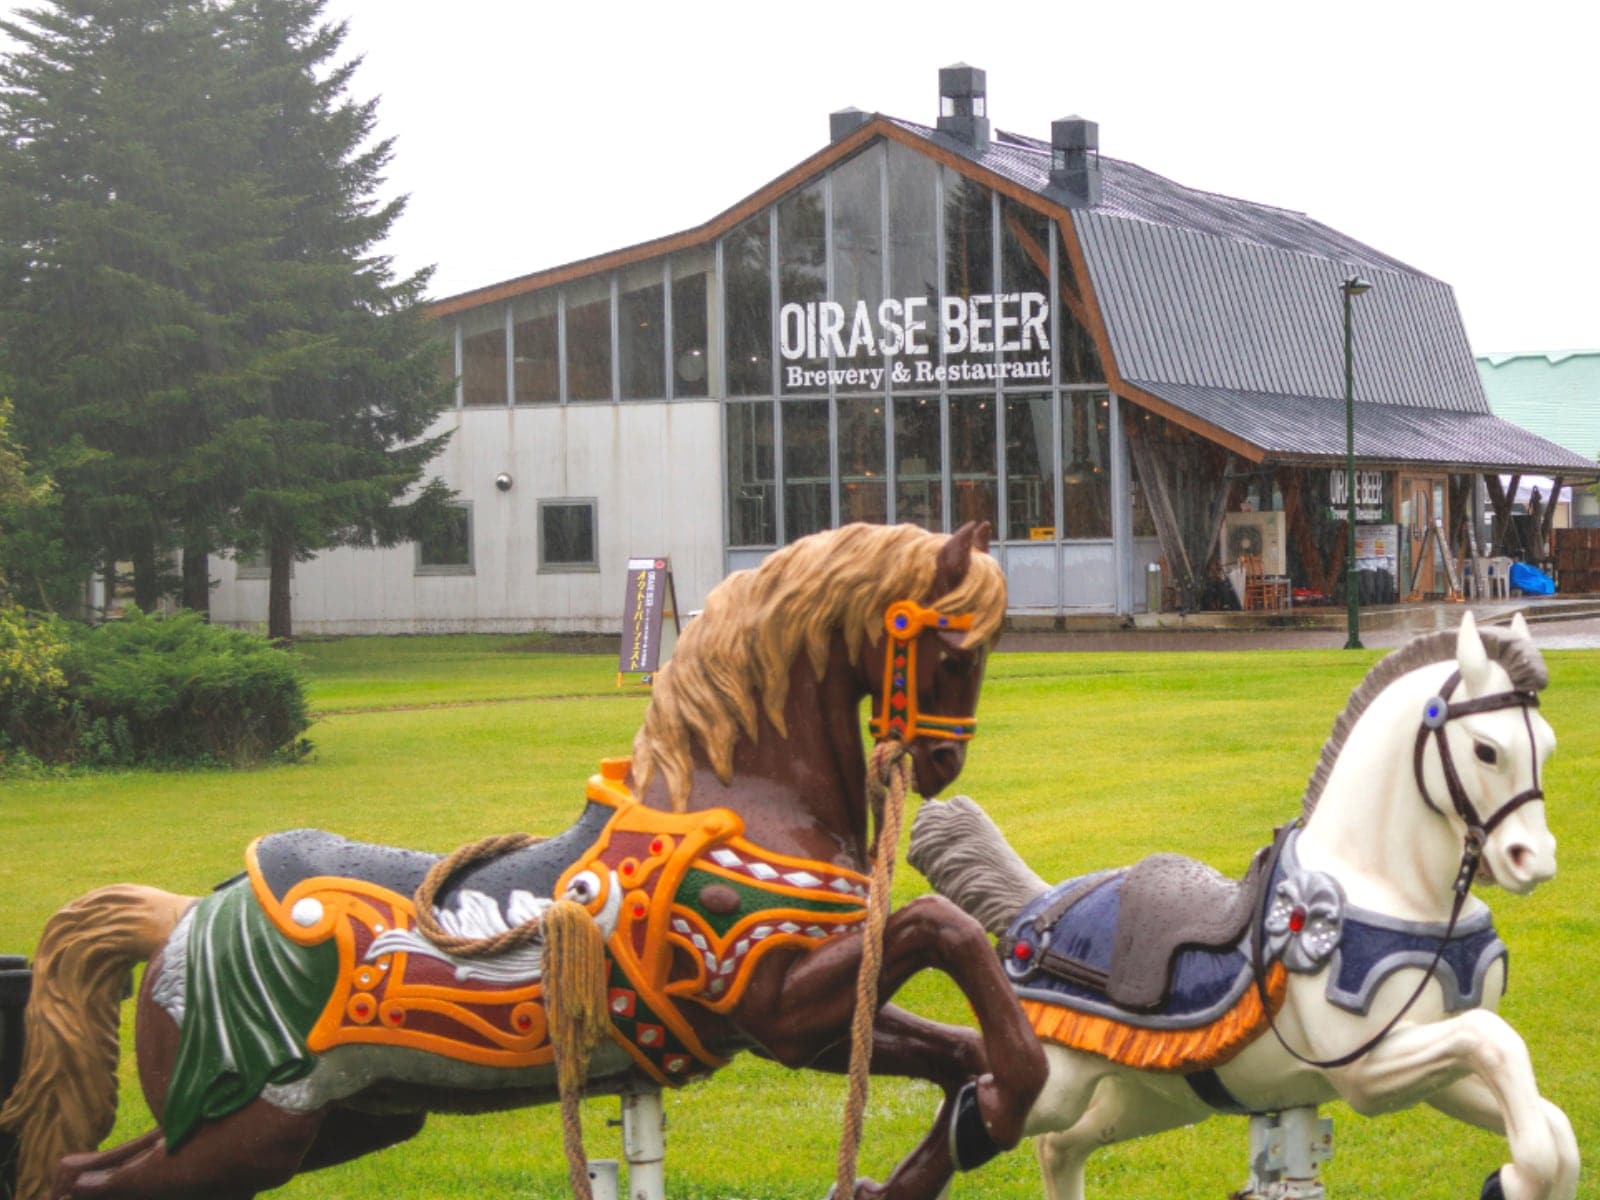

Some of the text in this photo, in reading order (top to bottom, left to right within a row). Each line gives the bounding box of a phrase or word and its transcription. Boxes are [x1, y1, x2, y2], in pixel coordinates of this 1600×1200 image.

[780, 292, 1050, 360] OIRASE BEER
[785, 356, 1050, 390] Brewery & Restaurant
[1361, 471, 1383, 504] BEER
